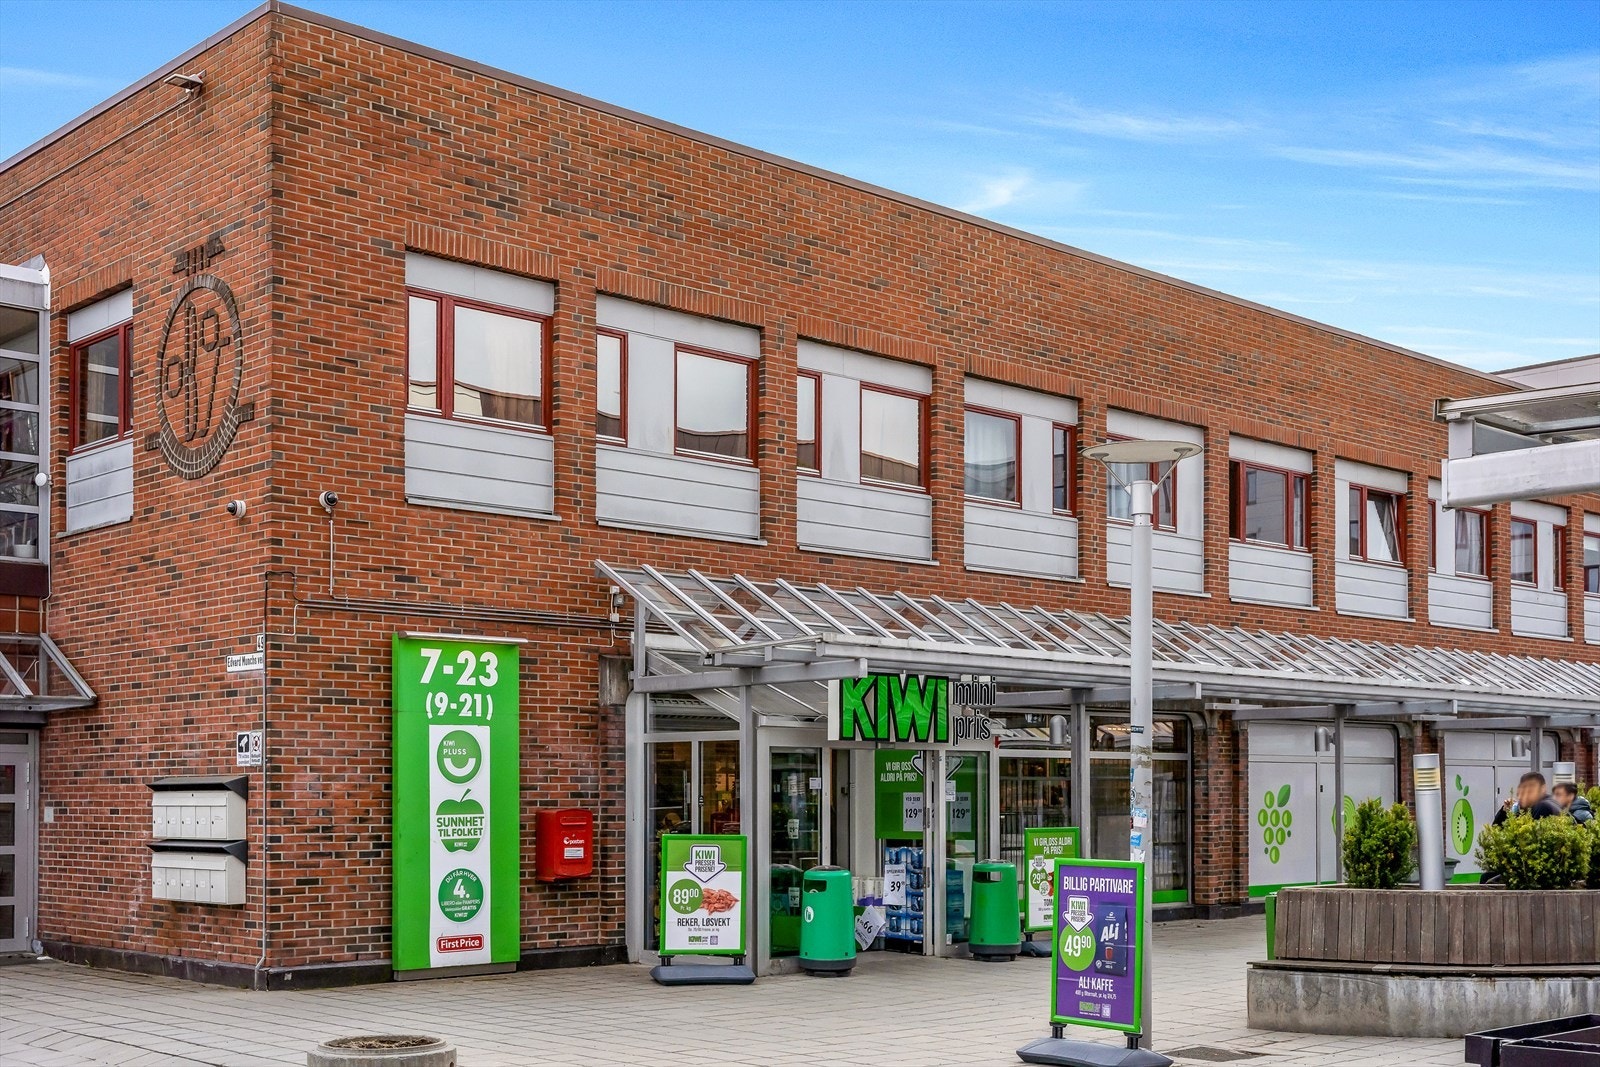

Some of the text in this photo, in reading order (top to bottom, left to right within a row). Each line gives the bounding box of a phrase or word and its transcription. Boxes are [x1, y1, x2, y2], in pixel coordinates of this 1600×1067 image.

[227, 656, 241, 667] Edvard
[242, 655, 257, 666] Munchs
[953, 675, 997, 705] mini
[839, 672, 949, 743] KIWI
[953, 709, 991, 746] pris
[885, 762, 911, 770] VI GIR OSS
[880, 771, 917, 781] ALDRI PÅ PRIS!
[436, 816, 485, 828] SUNNHET
[438, 828, 483, 837] TIL FOLKET
[1033, 838, 1039, 846] VI
[1048, 838, 1058, 846] OSS
[1059, 837, 1073, 845] ALDRI
[695, 850, 716, 859] KIWI
[445, 870, 477, 884] DU FÅR HVER
[453, 878, 470, 899] 4.
[1063, 876, 1088, 891] BILLIG
[1090, 878, 1133, 894] PARTIVARE
[1071, 900, 1086, 910] KIWI
[677, 918, 731, 927] REKER, LØSVEKT
[440, 938, 480, 949] First Price
[1078, 976, 1114, 992] ALI KAFFE
